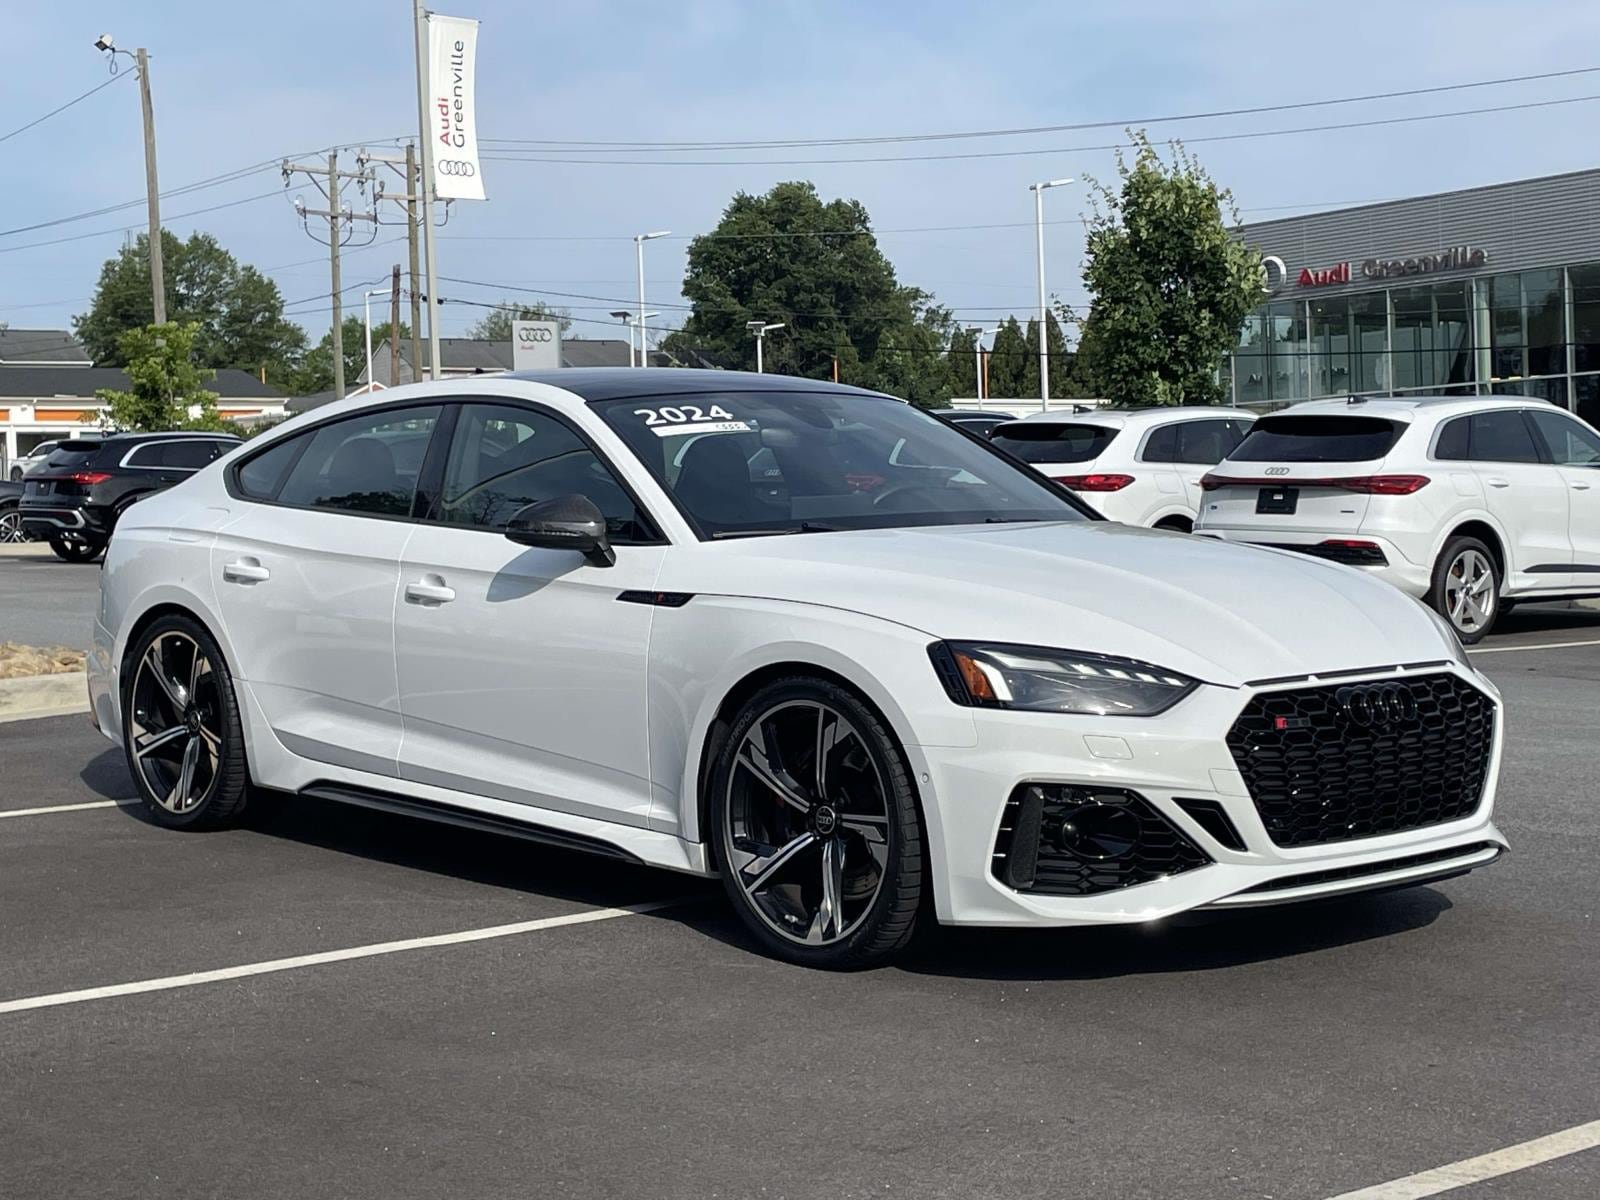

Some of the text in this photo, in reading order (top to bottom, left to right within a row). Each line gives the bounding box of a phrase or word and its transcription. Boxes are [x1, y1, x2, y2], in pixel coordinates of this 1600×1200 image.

[451, 40, 465, 148] Greenville
[438, 97, 451, 147] Audi
[1296, 246, 1489, 288] Audi Greenville
[634, 405, 734, 425] 2024
